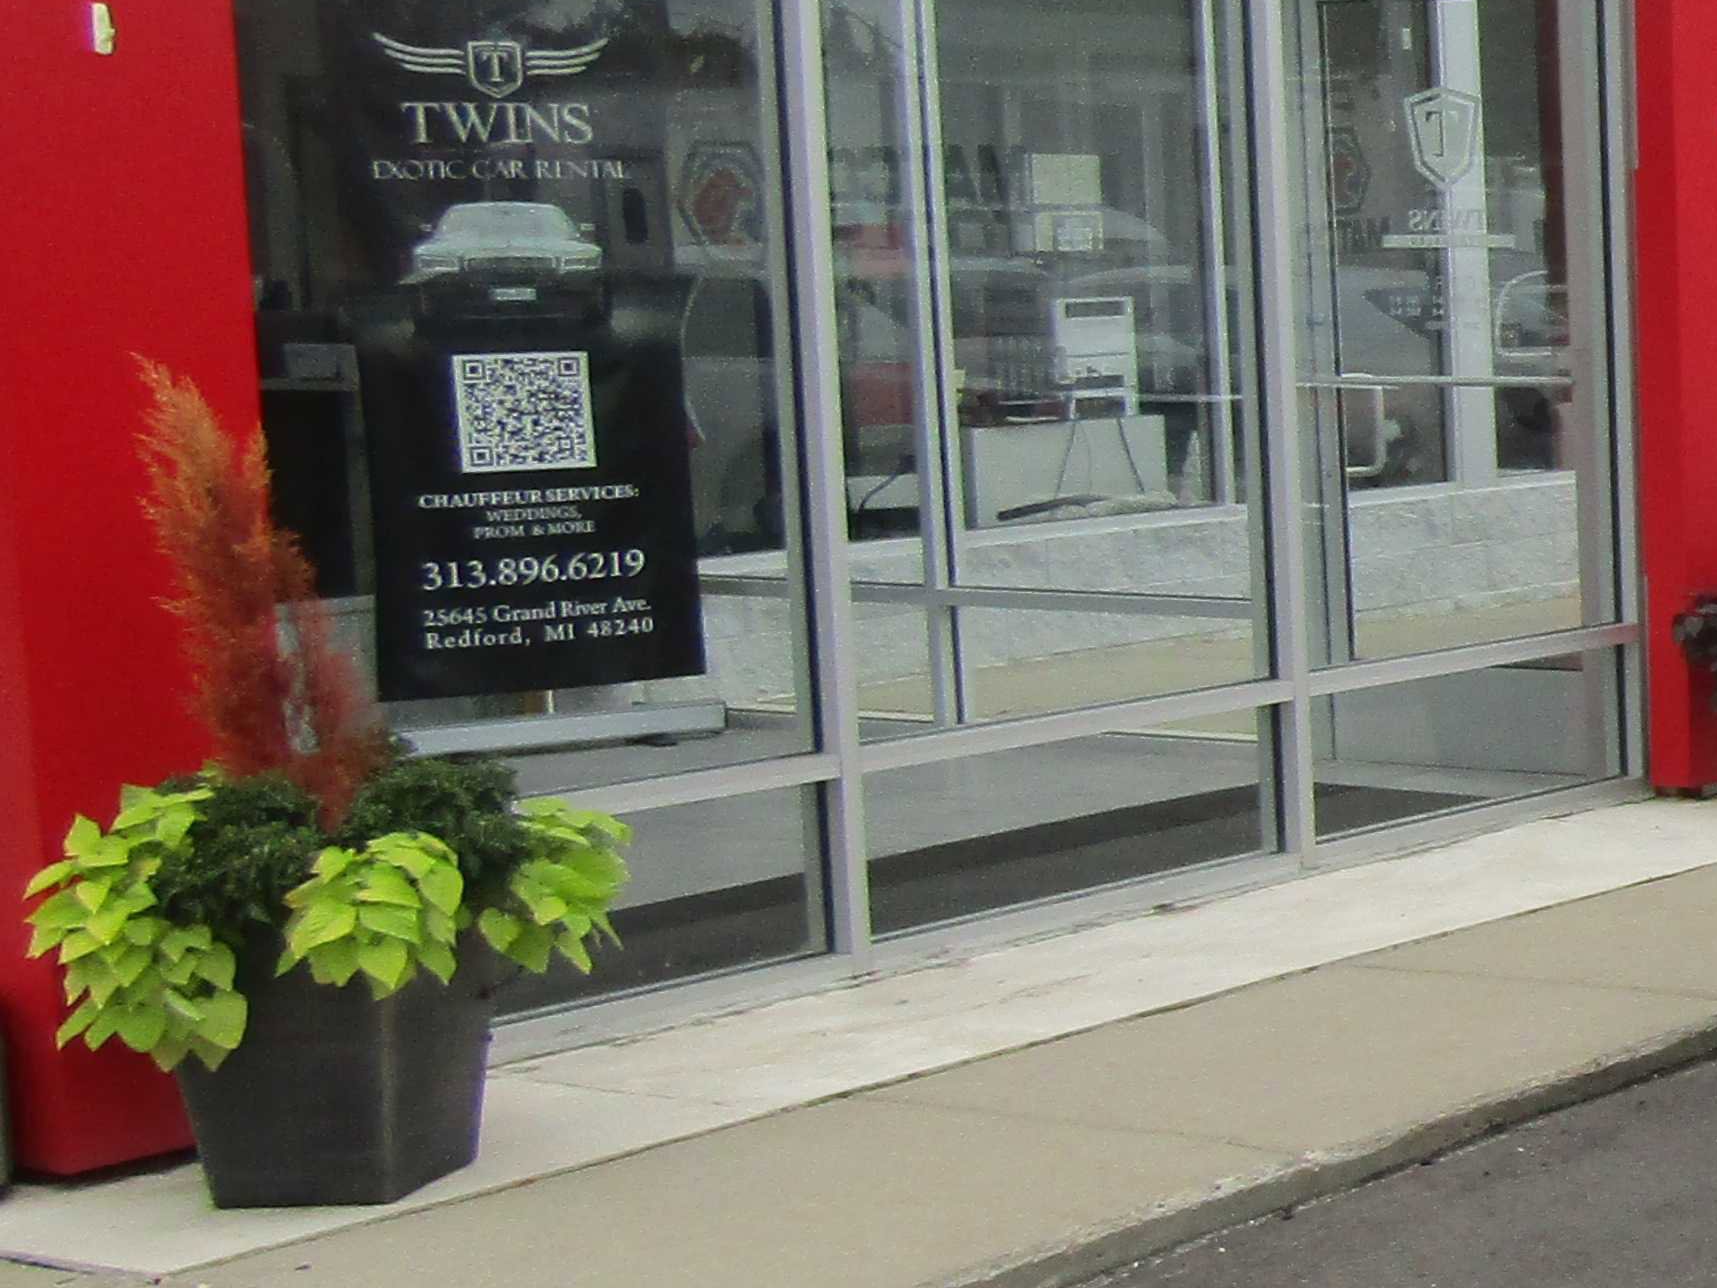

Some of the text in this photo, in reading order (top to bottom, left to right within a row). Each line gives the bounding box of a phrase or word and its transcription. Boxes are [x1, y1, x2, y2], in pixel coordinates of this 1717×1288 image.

[401, 101, 594, 145] TWINS
[371, 159, 466, 181] EXOTIC
[471, 160, 527, 181] CAR
[418, 483, 641, 509] CHAUFFEUR SERVICES:
[472, 520, 597, 540] PROM & MORE
[422, 548, 646, 591] 313.896.6219
[423, 596, 652, 627] 25645 Grand River Ave.
[425, 616, 655, 650] Redford, MI 48240
